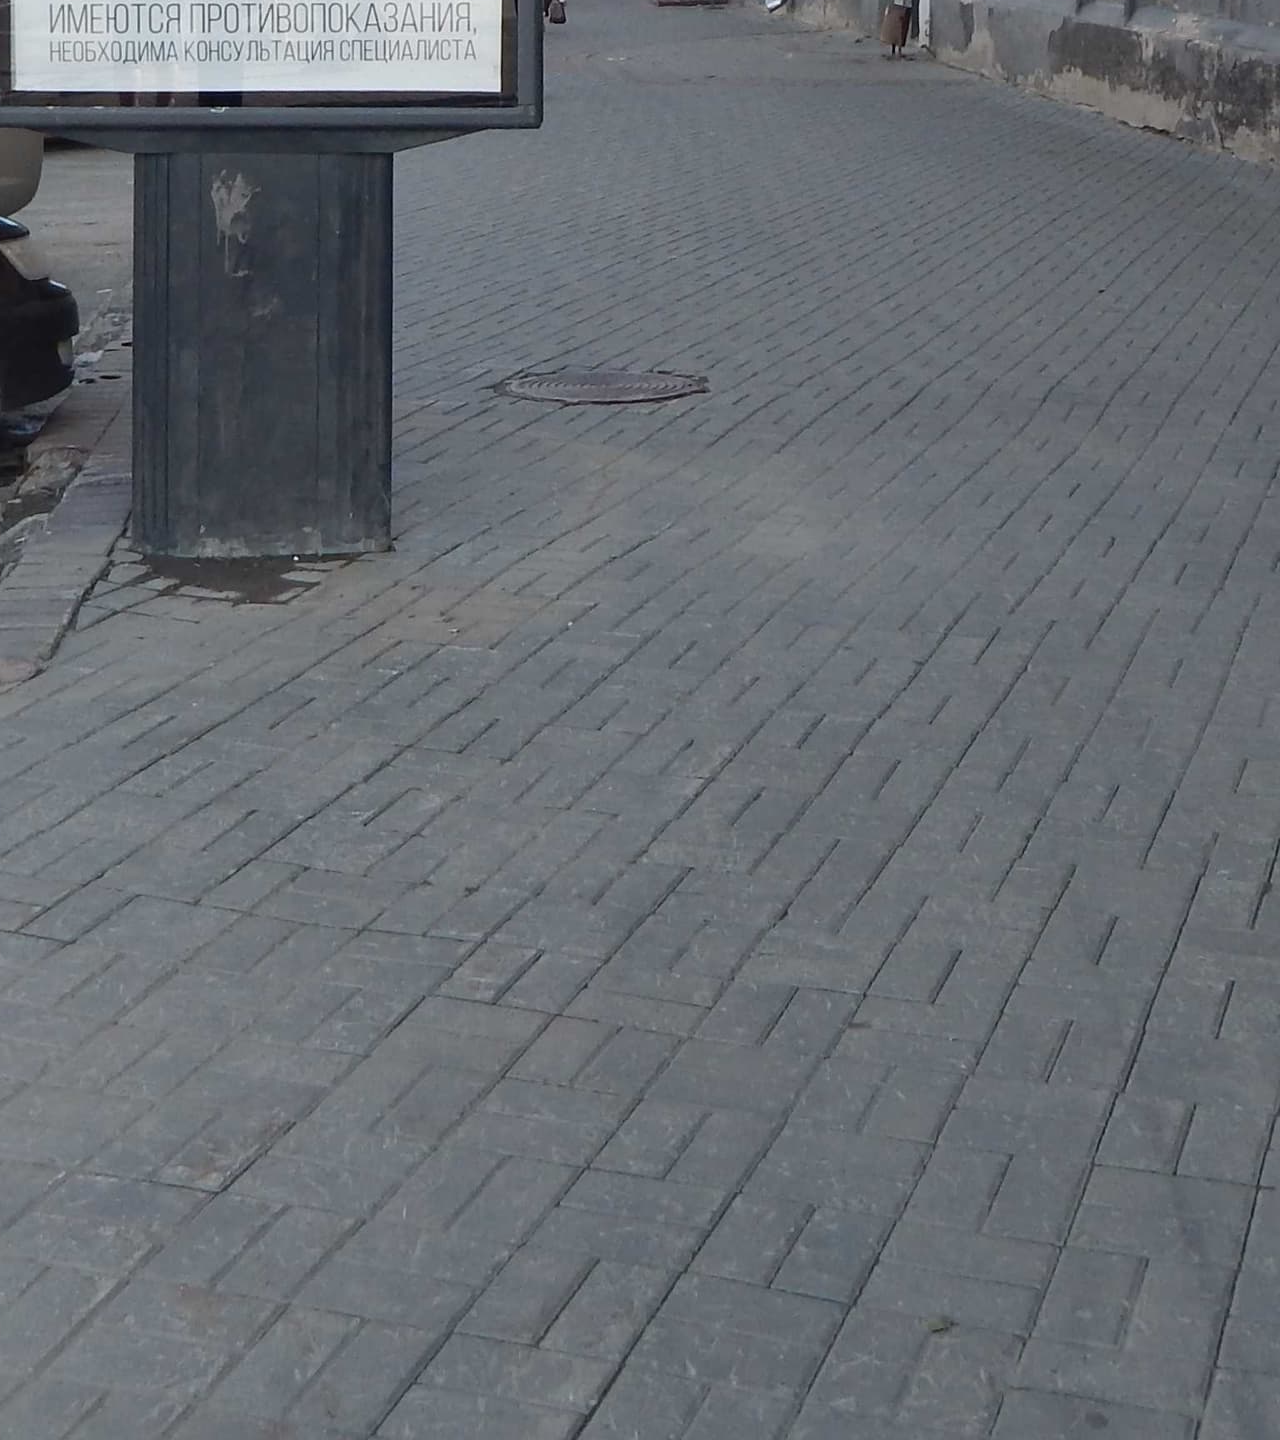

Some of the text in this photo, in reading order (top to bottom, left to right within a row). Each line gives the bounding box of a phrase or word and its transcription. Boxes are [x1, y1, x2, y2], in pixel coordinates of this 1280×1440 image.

[49, 2, 477, 35] ИМЕЮТСЯ ПРОТИВОПОКАЗАНИЯ,
[50, 39, 477, 64] НЕОБХОДИМА КОНСУЛЬТАЦИЯ СПЕЦИАЛИСТА
